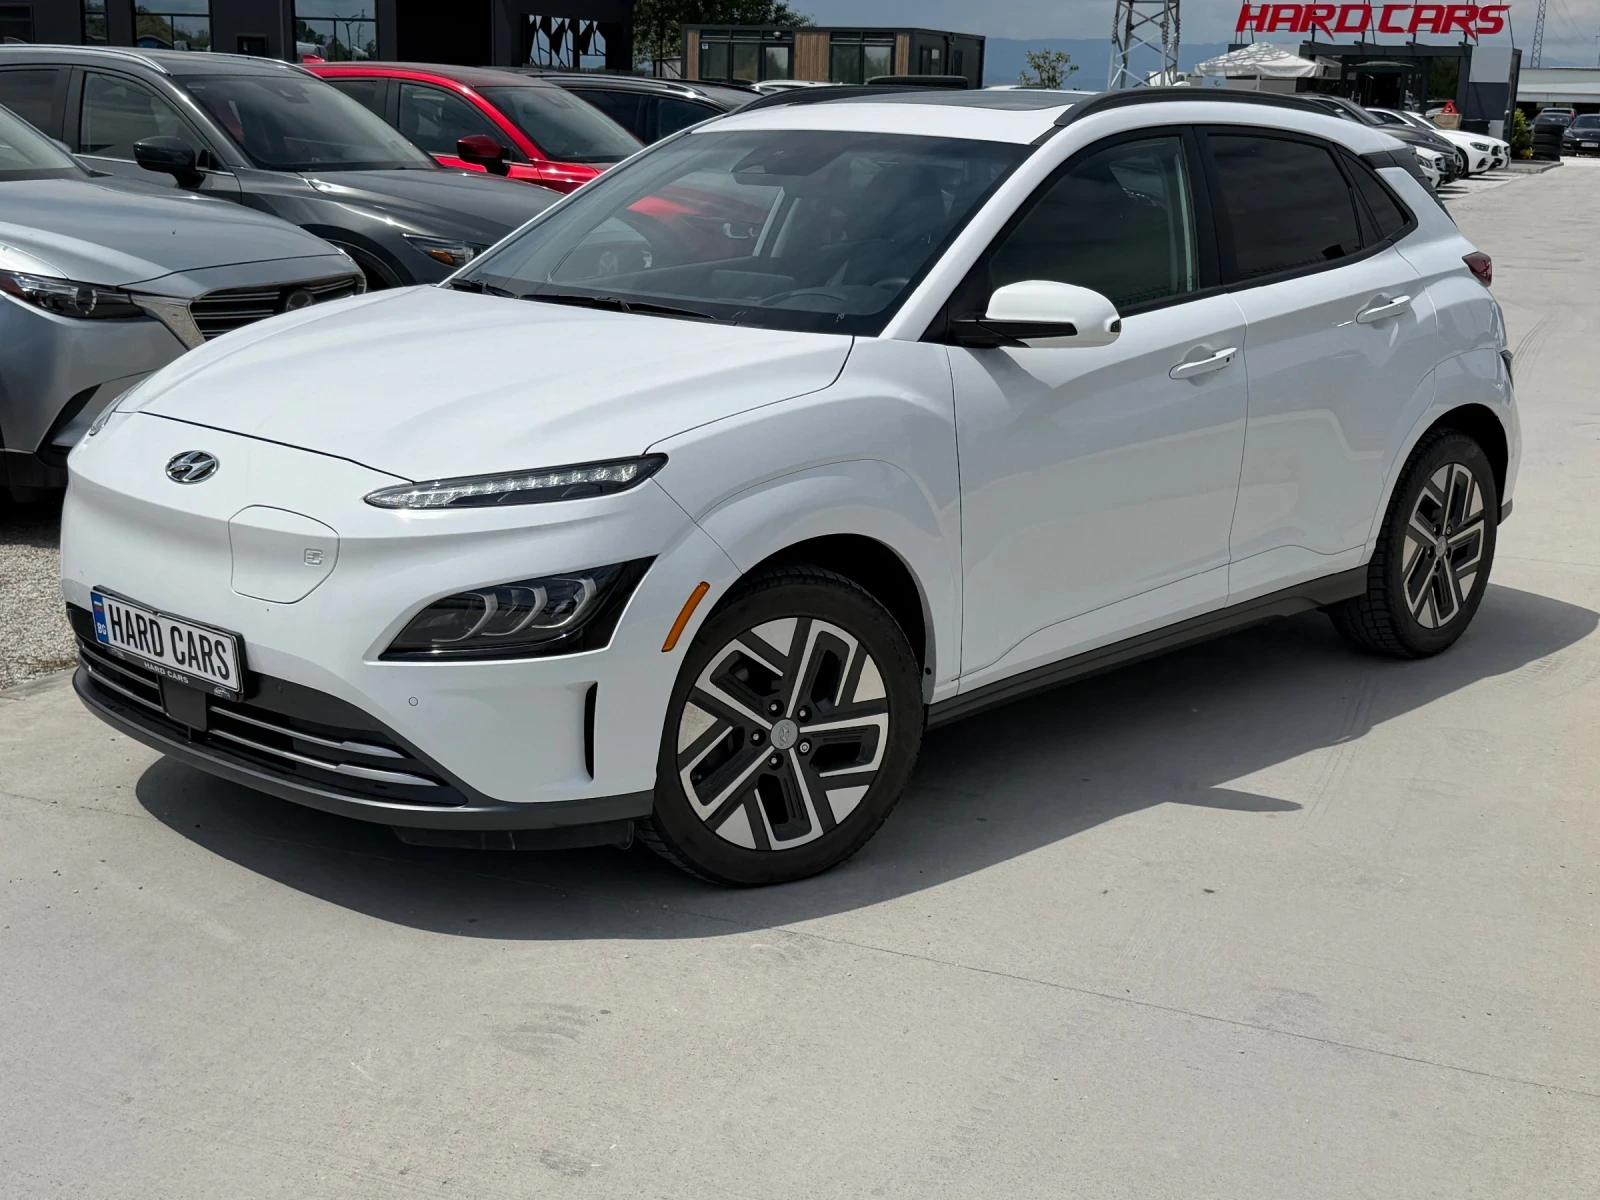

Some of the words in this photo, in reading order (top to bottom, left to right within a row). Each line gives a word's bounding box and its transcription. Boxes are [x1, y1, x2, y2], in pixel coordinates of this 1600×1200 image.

[1235, 4, 1372, 41] HARD
[1378, 4, 1512, 41] CARS
[97, 622, 107, 635] BG
[108, 604, 164, 658] HARD
[170, 626, 230, 680] CARS
[143, 661, 166, 675] HARD
[167, 670, 189, 684] CARS
